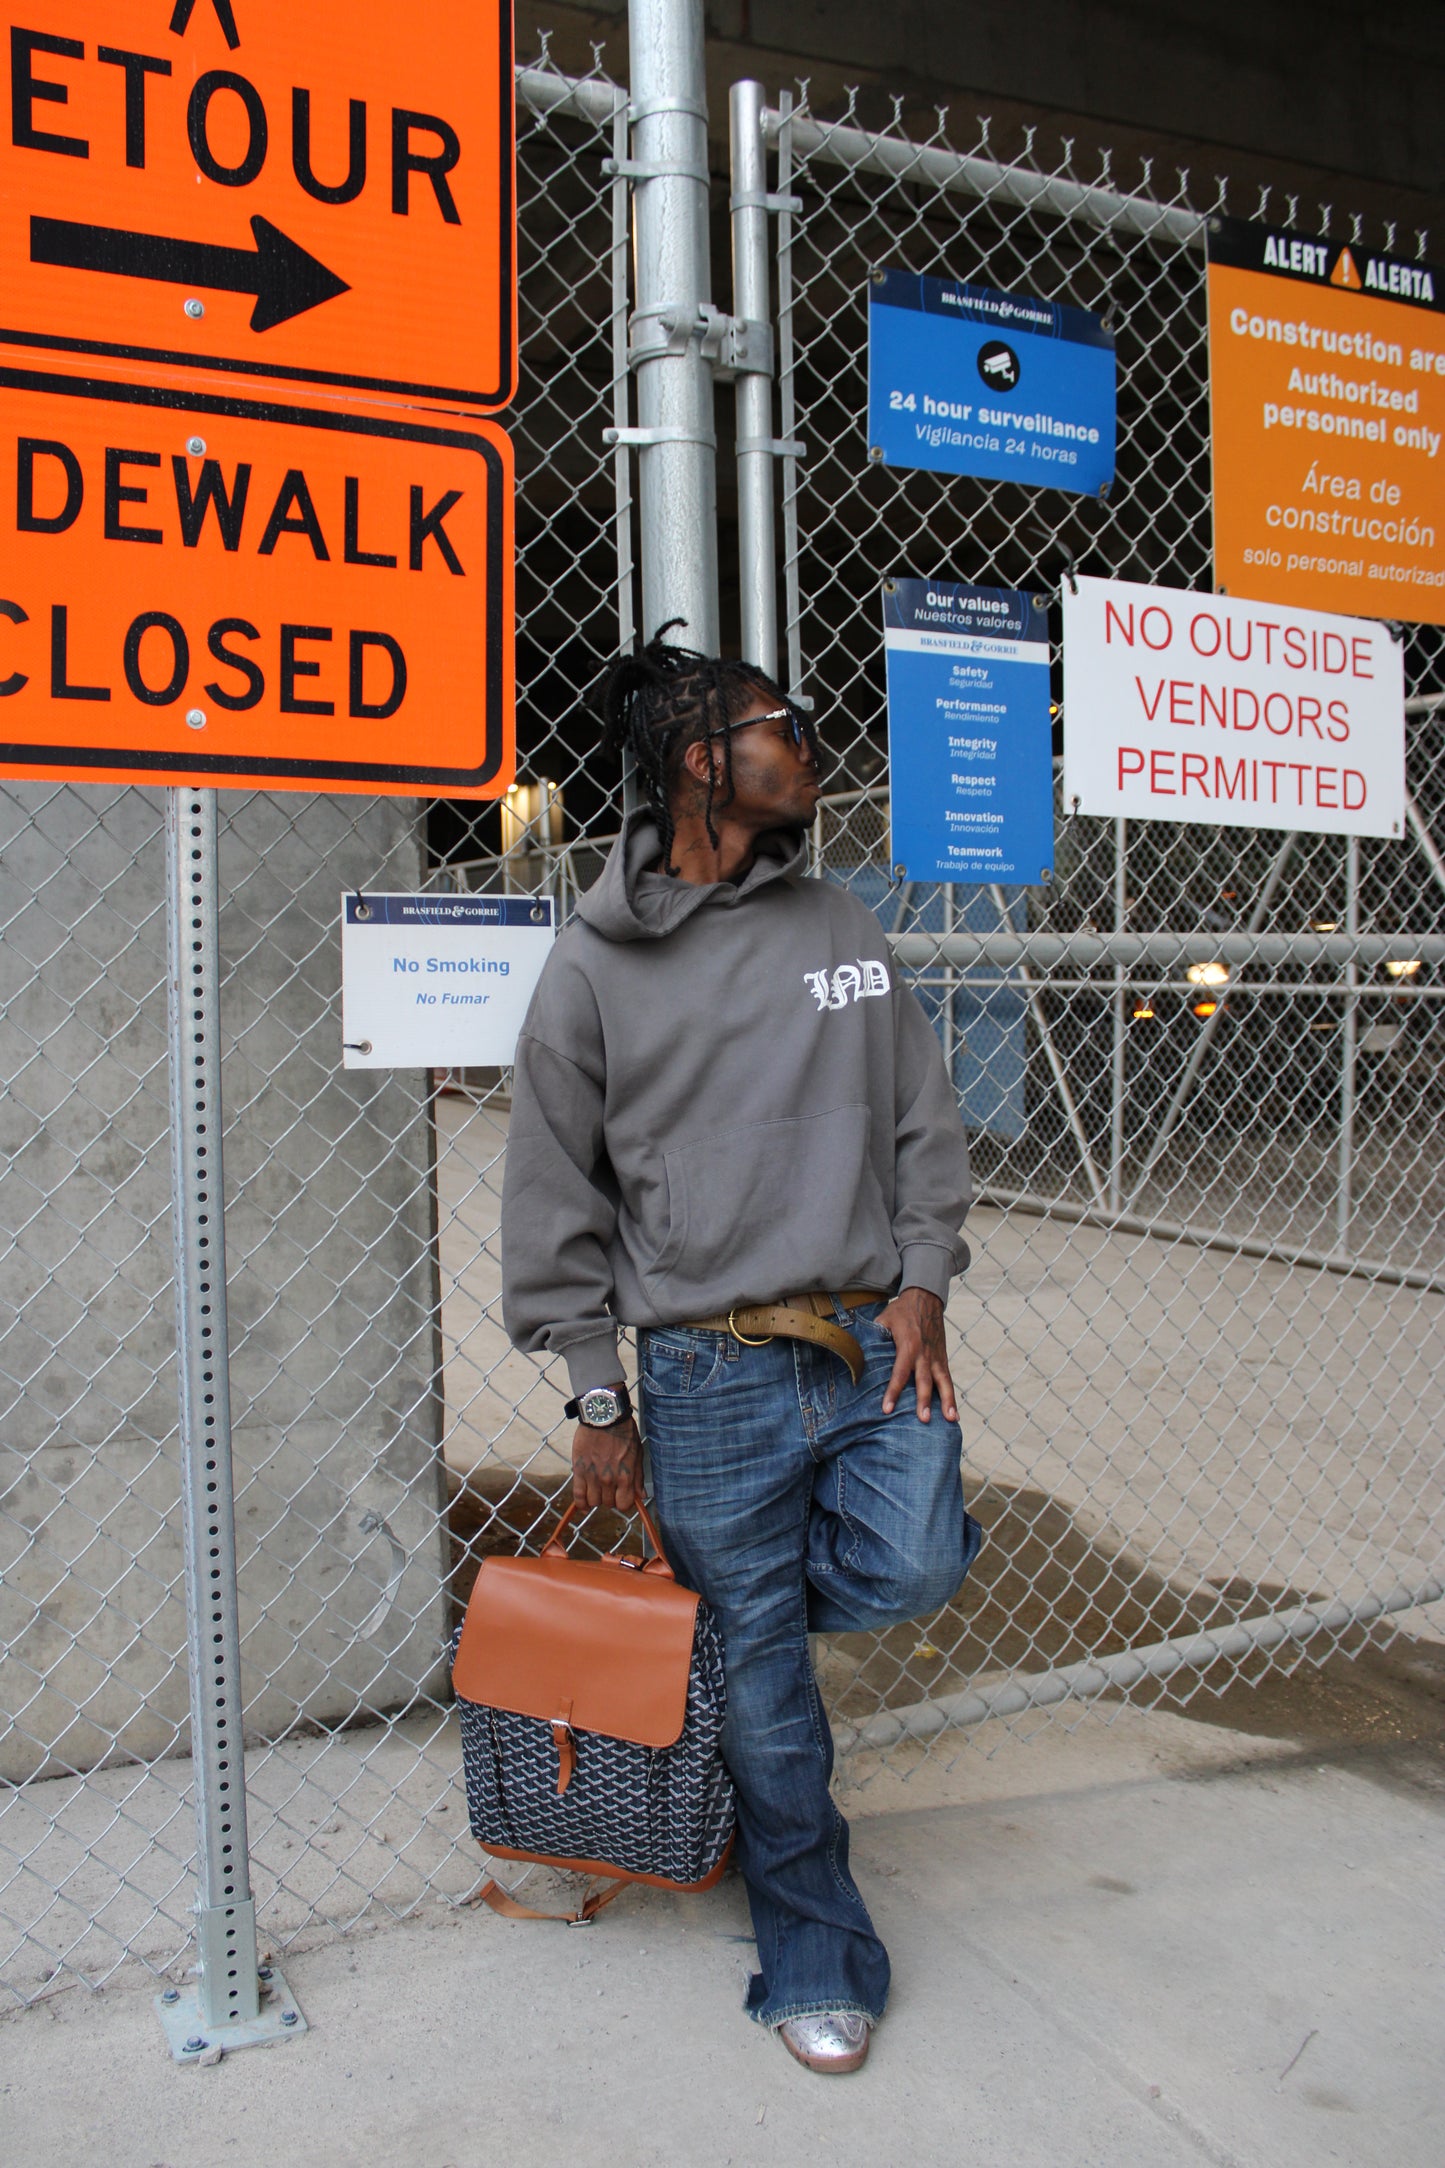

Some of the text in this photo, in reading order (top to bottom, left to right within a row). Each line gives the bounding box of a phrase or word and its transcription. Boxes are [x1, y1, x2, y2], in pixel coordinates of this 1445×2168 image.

[10, 25, 461, 226] ETOUR
[1263, 236, 1434, 302] ALERT ALERTA
[1230, 308, 1402, 366] Construction
[1288, 368, 1418, 414] Authorized
[889, 391, 1099, 444] 24 hour surveillance
[1264, 402, 1441, 457] personnel only
[915, 424, 1077, 465] Vigilancia 24 horas
[1302, 460, 1401, 505] Área de
[16, 437, 466, 577] DEWALK
[1265, 504, 1435, 547] construcción
[1243, 547, 1281, 567] solo
[1287, 553, 1362, 577] personal
[926, 592, 1009, 614] Our values
[914, 608, 1022, 631] Nuestros valores
[1105, 600, 1374, 679] NO OUTSIDE
[949, 677, 993, 689] Seguridad
[952, 665, 988, 680] Safety
[936, 698, 1007, 714] Performance
[944, 711, 999, 723] Rendimiento
[1135, 676, 1350, 742] VENDORS
[948, 736, 997, 752] Integrity
[950, 748, 996, 760] Integridad
[951, 774, 996, 788] Respect
[1118, 747, 1367, 811] PERMITTED
[956, 786, 992, 797] Respeto
[945, 810, 1004, 824] Innovation
[950, 822, 999, 834] Innovación
[947, 845, 1003, 858] Teamwork
[935, 860, 1015, 872] Trabajo de equipo
[393, 957, 510, 976] No Smoking
[416, 993, 490, 1004] No Fumar
